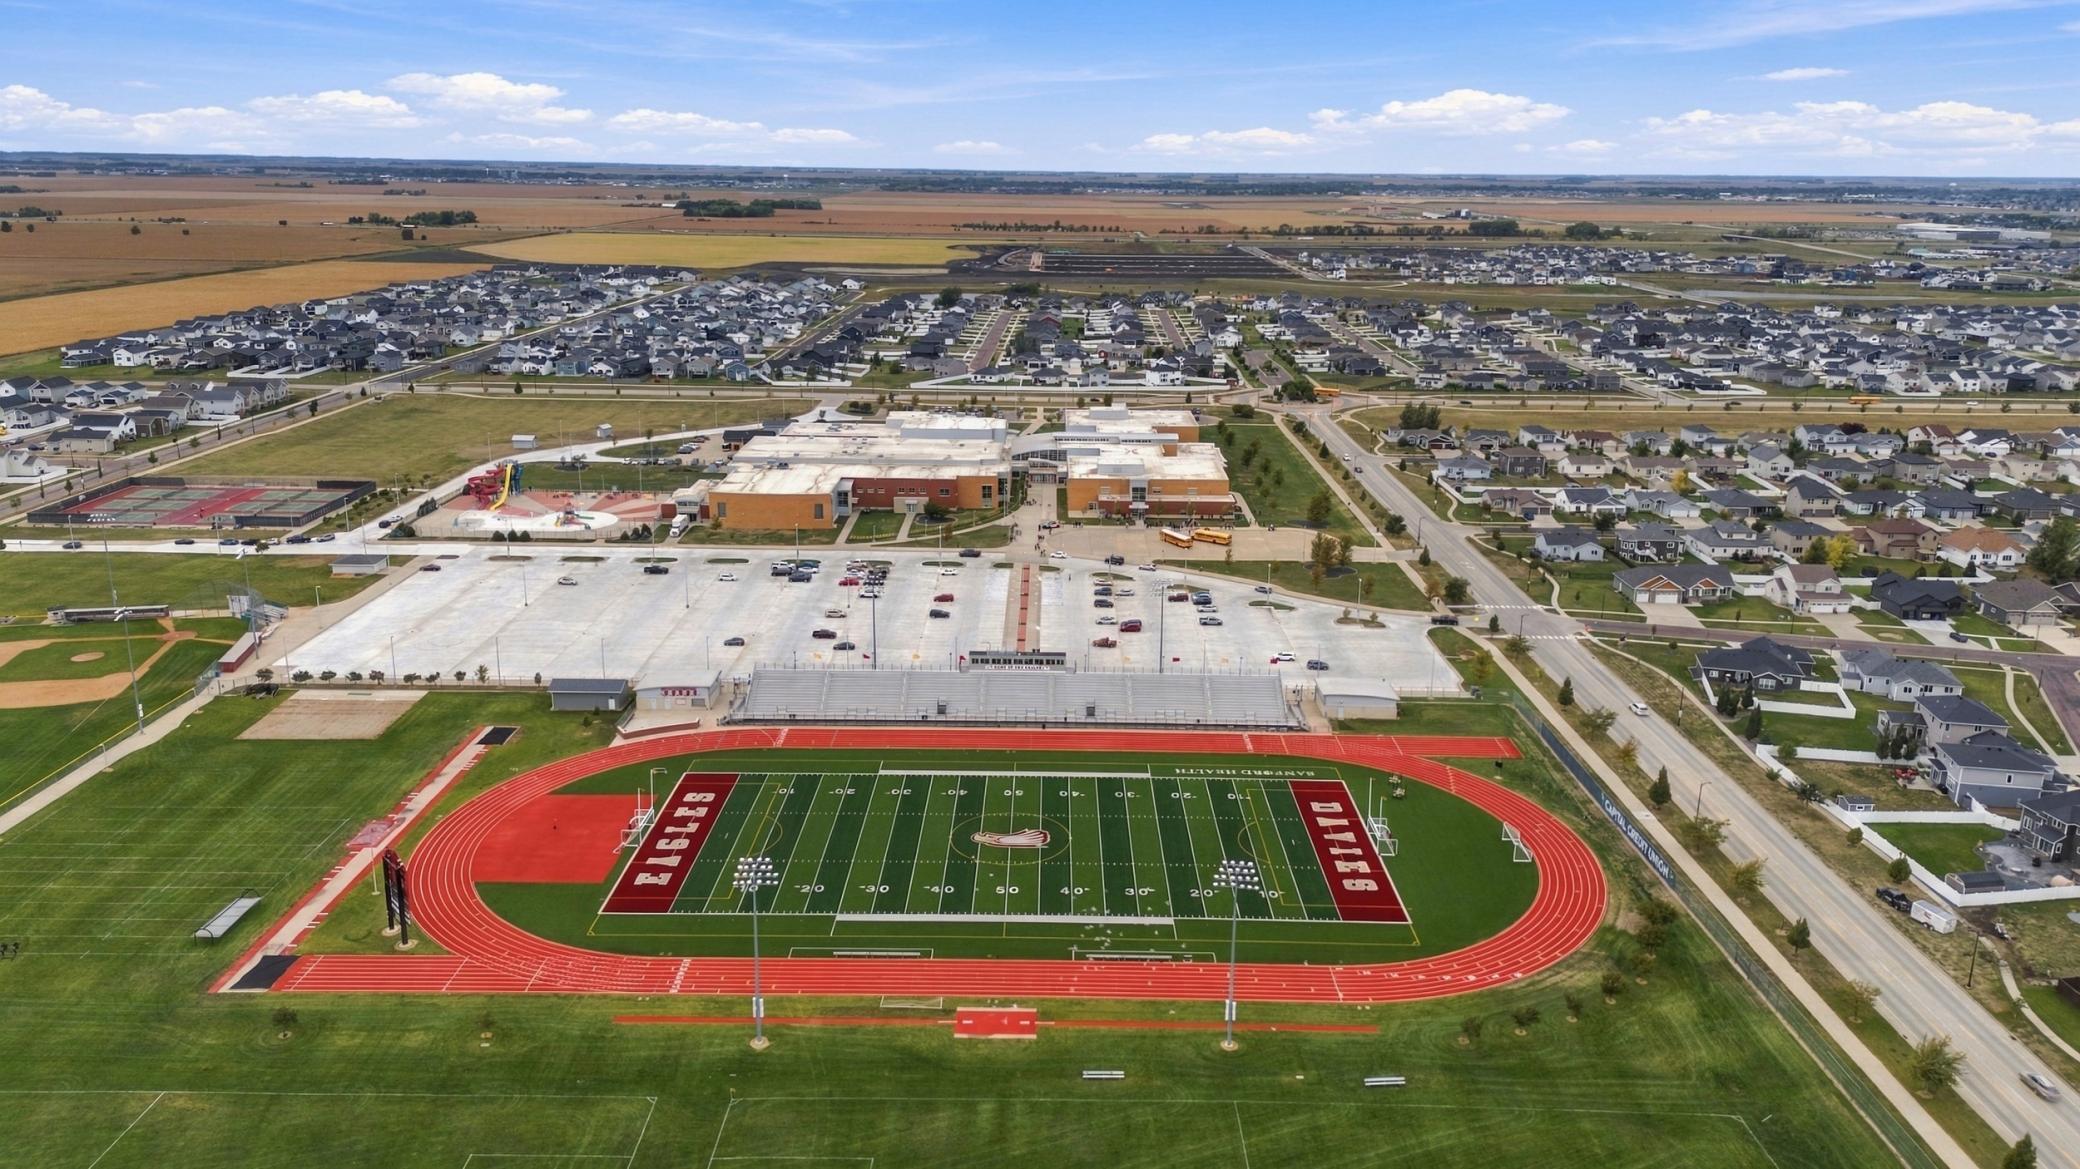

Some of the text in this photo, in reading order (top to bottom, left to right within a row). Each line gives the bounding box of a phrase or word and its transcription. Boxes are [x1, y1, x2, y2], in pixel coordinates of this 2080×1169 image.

[1241, 769, 1316, 777] SANFORD
[1003, 789, 1024, 797] 50
[633, 792, 716, 885] EAGLES
[1604, 799, 1669, 879] CAPITAL CREDIT UNION
[1310, 801, 1379, 891] DAVIES
[800, 884, 825, 893] 20
[865, 884, 890, 893] 30
[930, 885, 955, 894] 40
[995, 886, 1020, 894] 50
[1060, 886, 1084, 895] 40
[1124, 887, 1150, 896] 30
[1190, 889, 1214, 897] 20
[1258, 890, 1279, 899] 10
